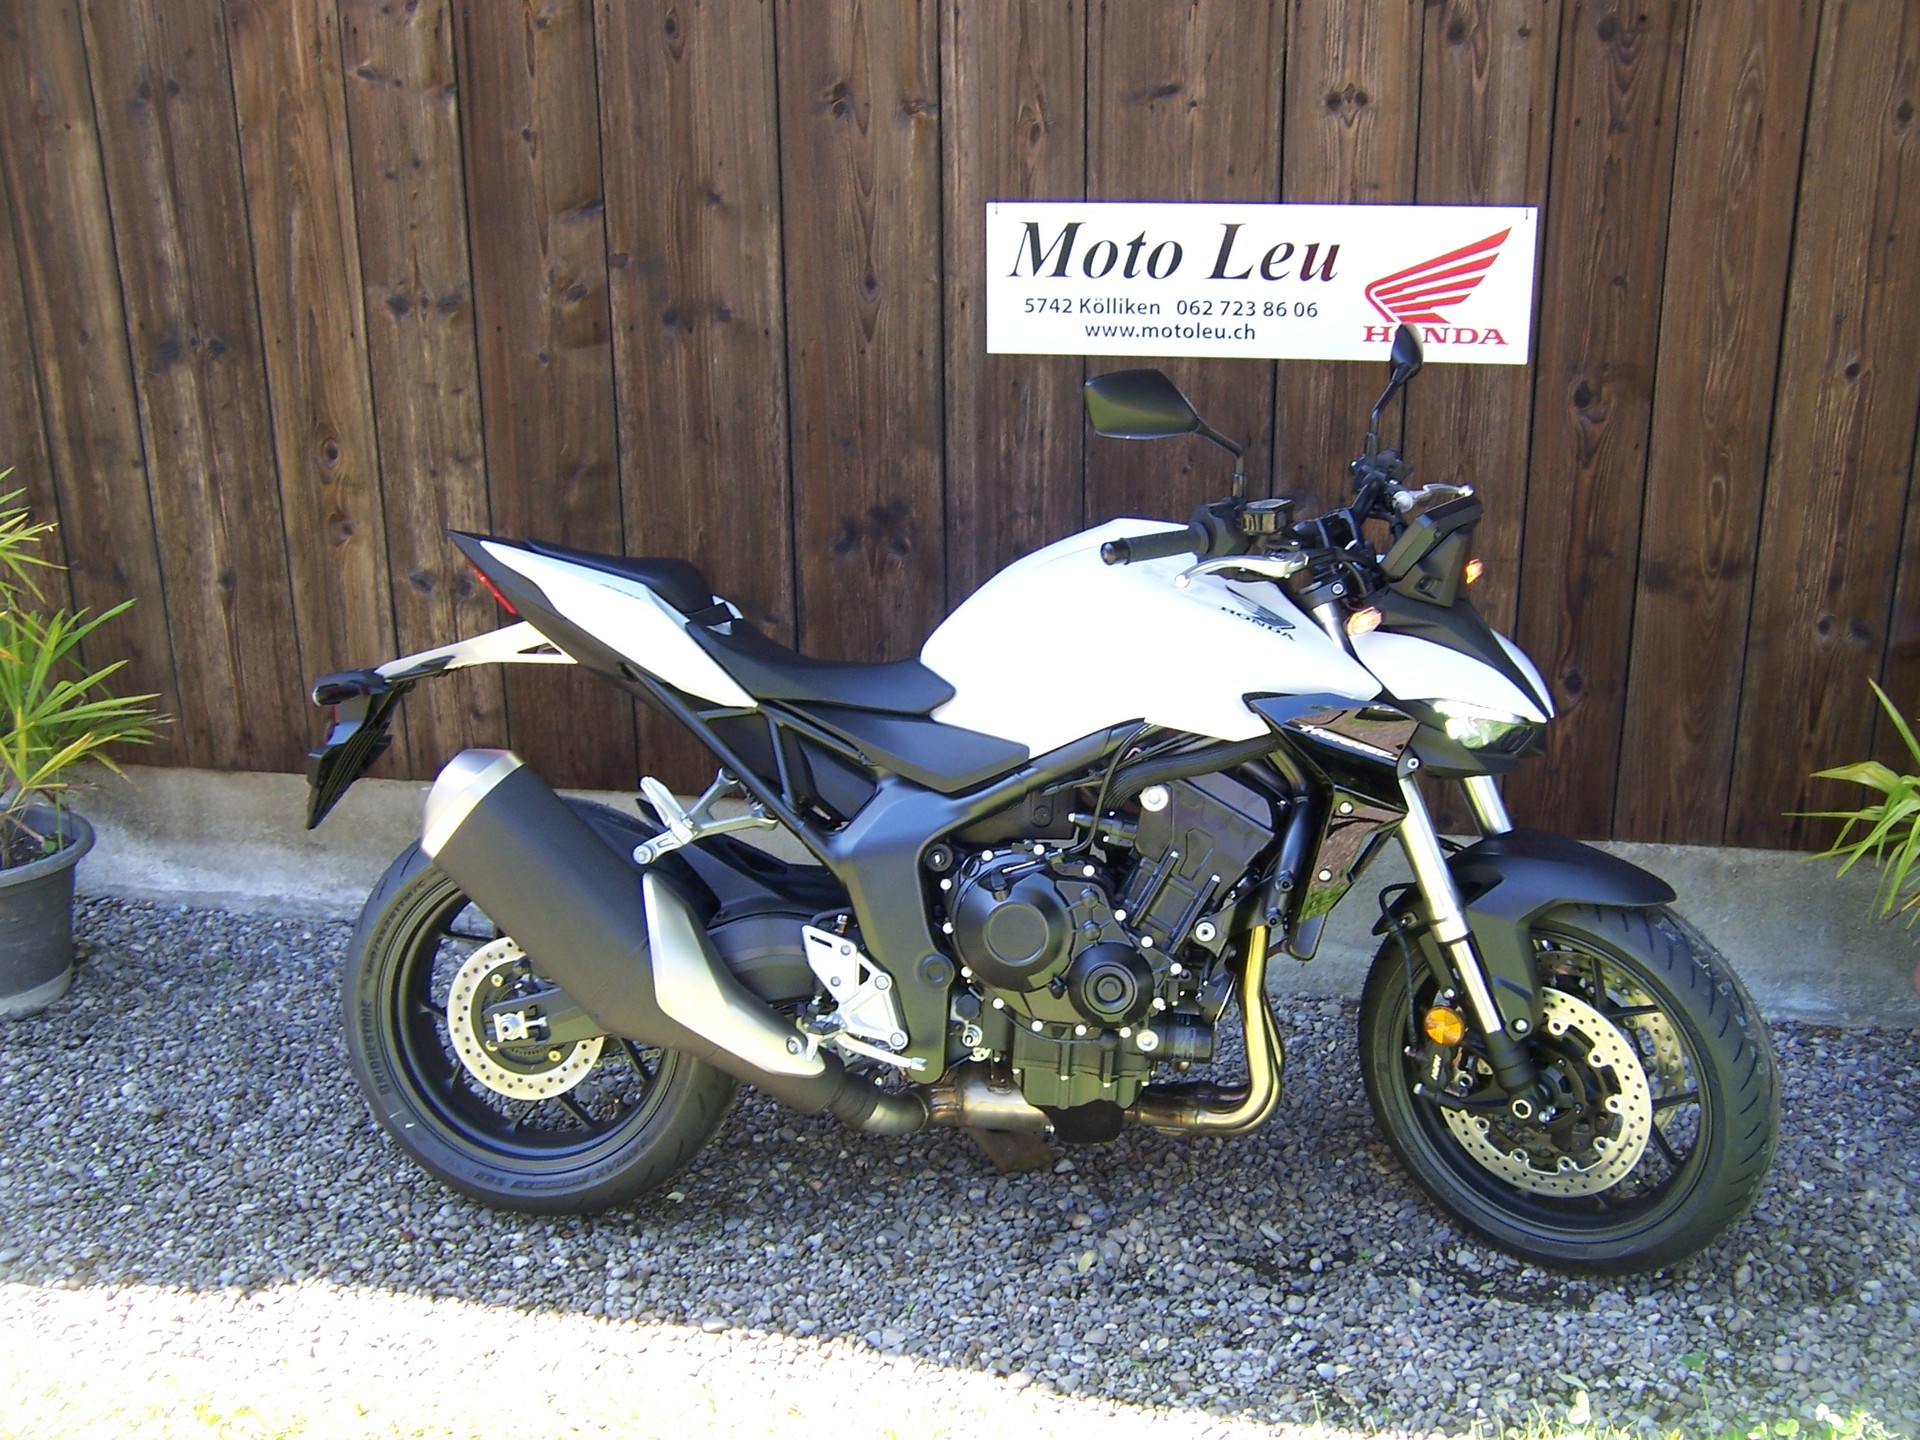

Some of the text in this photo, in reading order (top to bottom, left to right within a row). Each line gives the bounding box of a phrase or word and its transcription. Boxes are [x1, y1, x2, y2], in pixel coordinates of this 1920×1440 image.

[1008, 221, 1342, 282] Moto Leu
[1025, 296, 1318, 318] 5742 Kölliken 062 723 86 06
[1085, 322, 1255, 340] www.motoleu.ch
[1363, 325, 1509, 345] HNDA
[1220, 606, 1296, 642] HONDA
